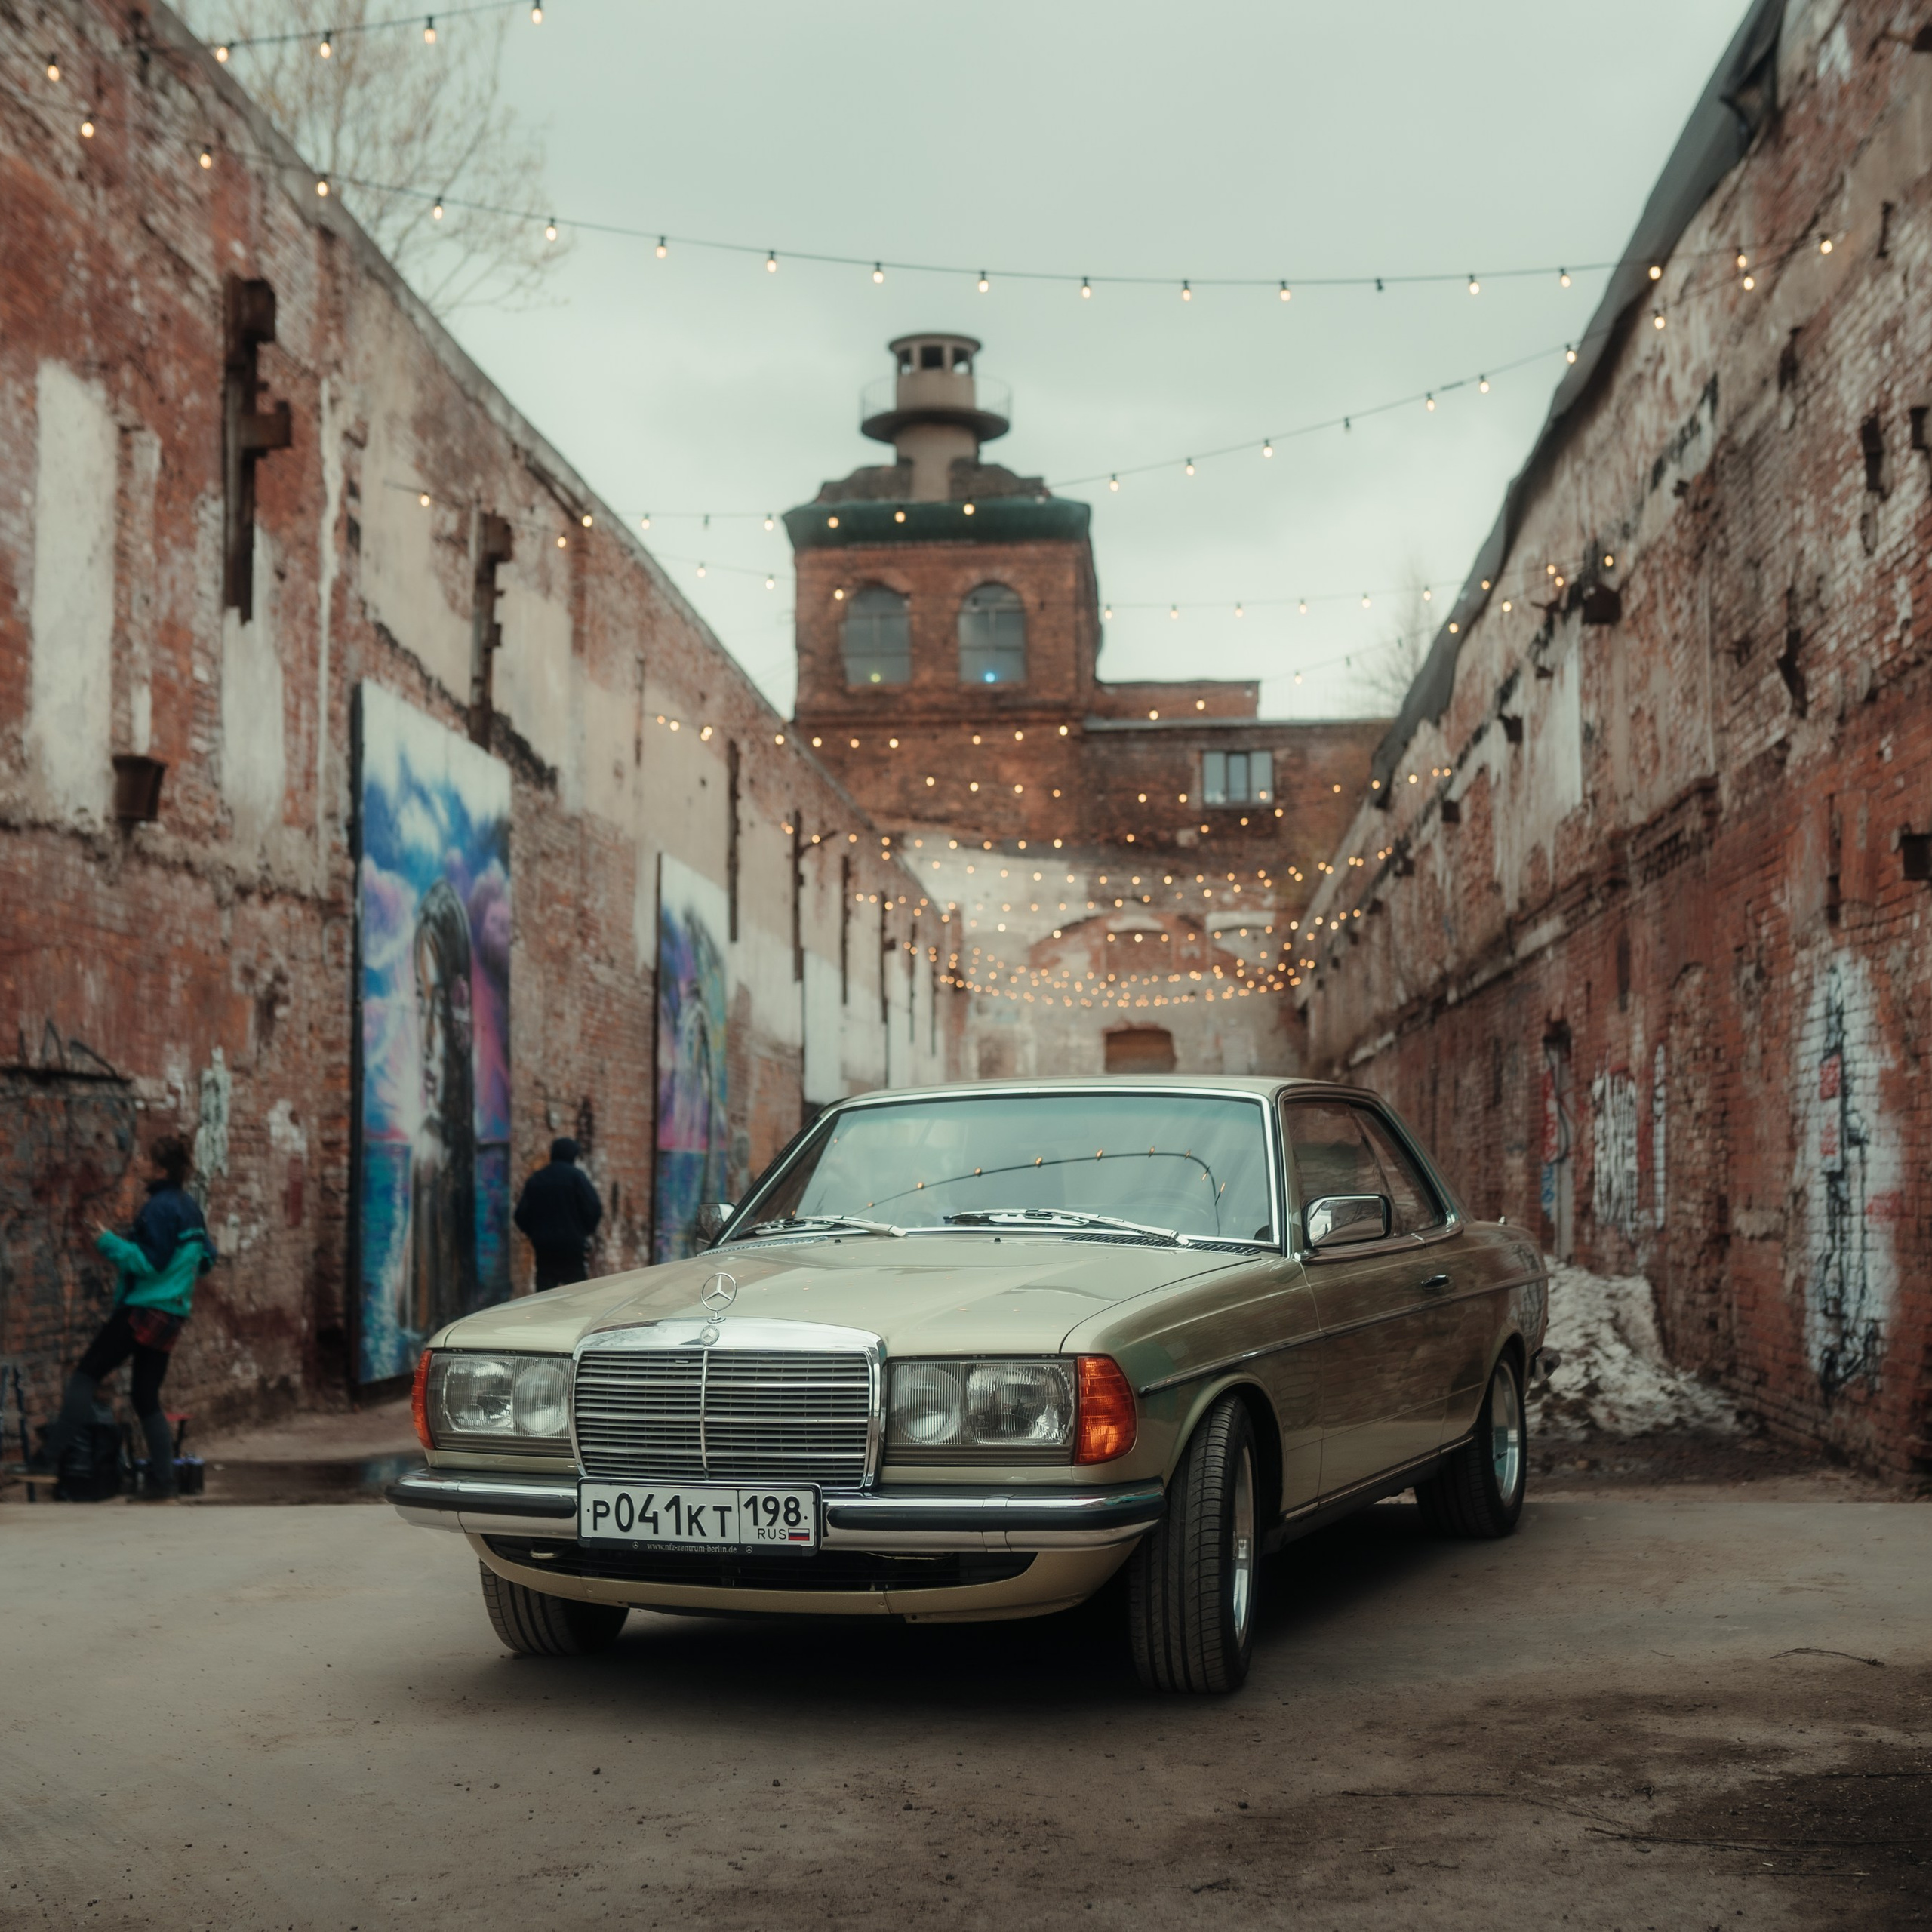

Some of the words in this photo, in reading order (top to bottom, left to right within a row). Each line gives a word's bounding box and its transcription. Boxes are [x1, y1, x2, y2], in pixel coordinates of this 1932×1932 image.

[743, 1495, 801, 1527] 198
[758, 1528, 786, 1540] RUS
[647, 1543, 737, 1553] www.nfz-zentrum-berlin.de
